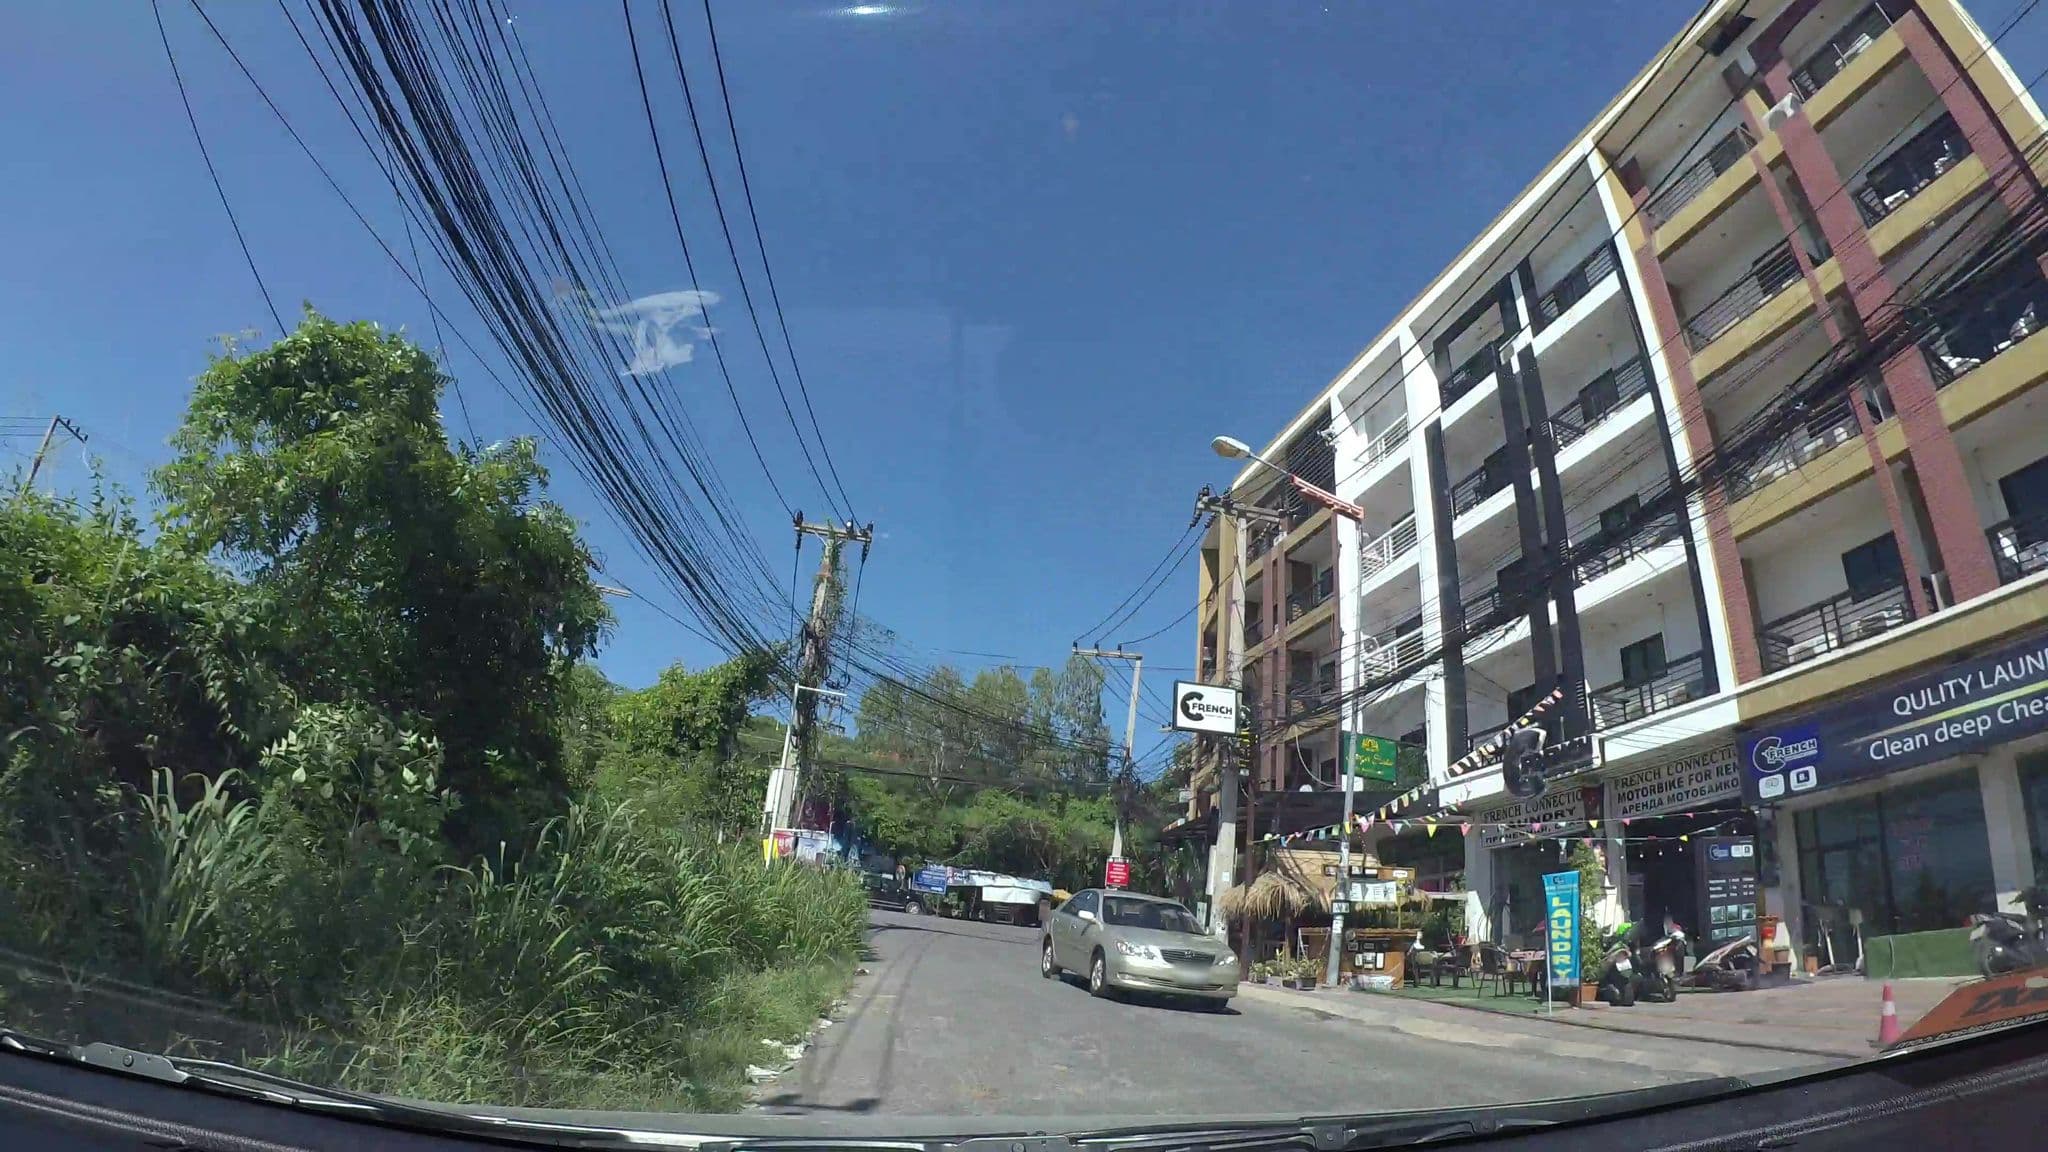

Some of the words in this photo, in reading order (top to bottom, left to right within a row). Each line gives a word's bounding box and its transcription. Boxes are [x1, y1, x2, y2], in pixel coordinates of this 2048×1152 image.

[1893, 673, 1973, 716] QULITY
[1978, 647, 2048, 690] LAUN
[1192, 703, 1233, 715] FRENCH
[1769, 739, 1817, 759] FRENCH
[1870, 732, 1929, 760] Clean
[1934, 714, 1992, 743] deep
[1614, 767, 1661, 790] FRENCH
[1666, 748, 1737, 777] CONNECTI
[1617, 778, 1685, 804] MOTORBIKE
[1688, 769, 1713, 786] FOR
[1484, 804, 1522, 824] FRENCH
[1621, 796, 1665, 815] АРЕНДА
[1551, 896, 1573, 979] LAUNDRY
